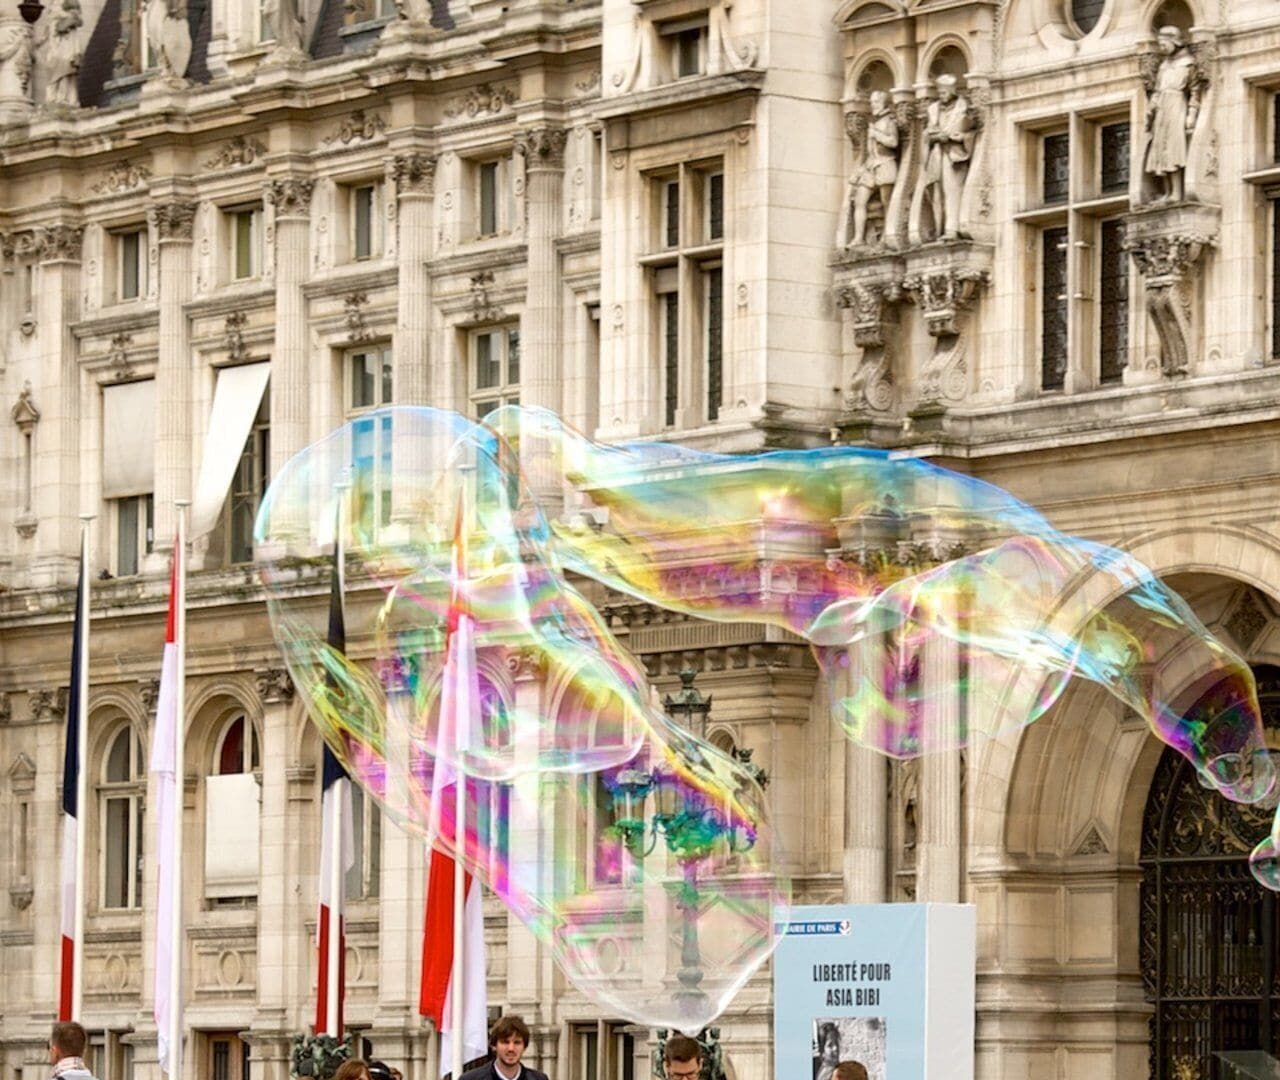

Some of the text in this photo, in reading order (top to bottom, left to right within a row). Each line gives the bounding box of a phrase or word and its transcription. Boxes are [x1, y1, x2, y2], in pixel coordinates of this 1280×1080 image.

[812, 960, 892, 982] LIBERTÉ POUR
[825, 987, 880, 1007] ASIA BIBI
